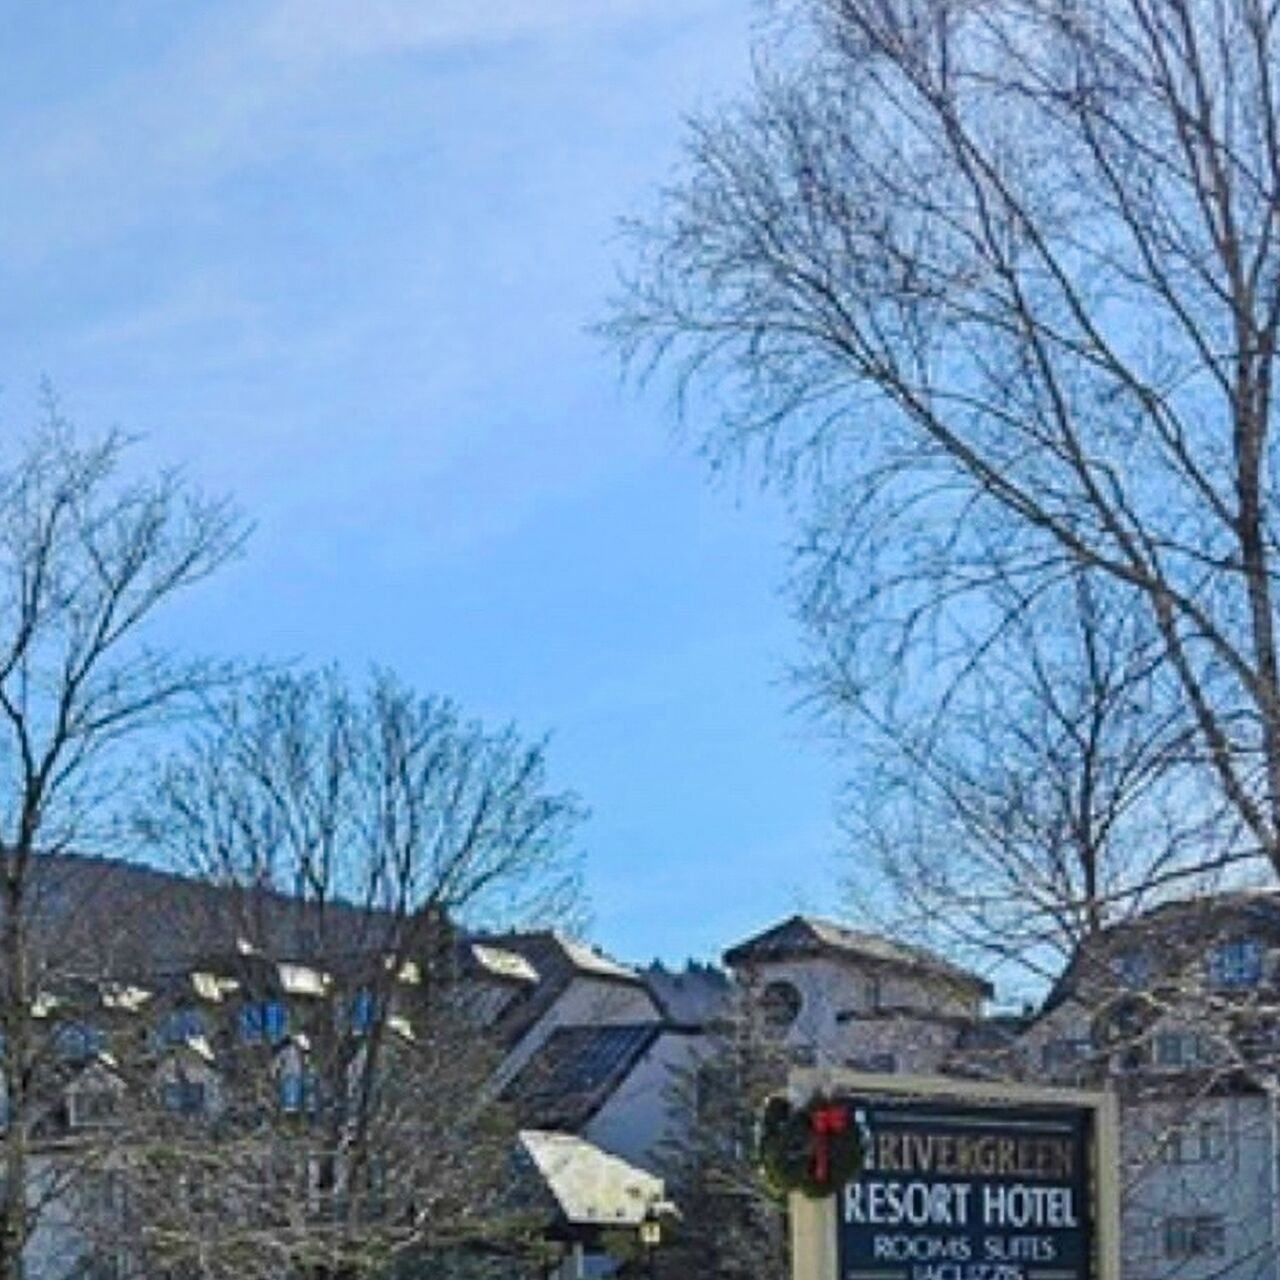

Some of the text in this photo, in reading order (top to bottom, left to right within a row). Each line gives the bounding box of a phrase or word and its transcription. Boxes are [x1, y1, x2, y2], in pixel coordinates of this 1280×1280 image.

[844, 1182, 1078, 1228] RESORT HOTEL
[873, 1235, 972, 1261] ROOMS
